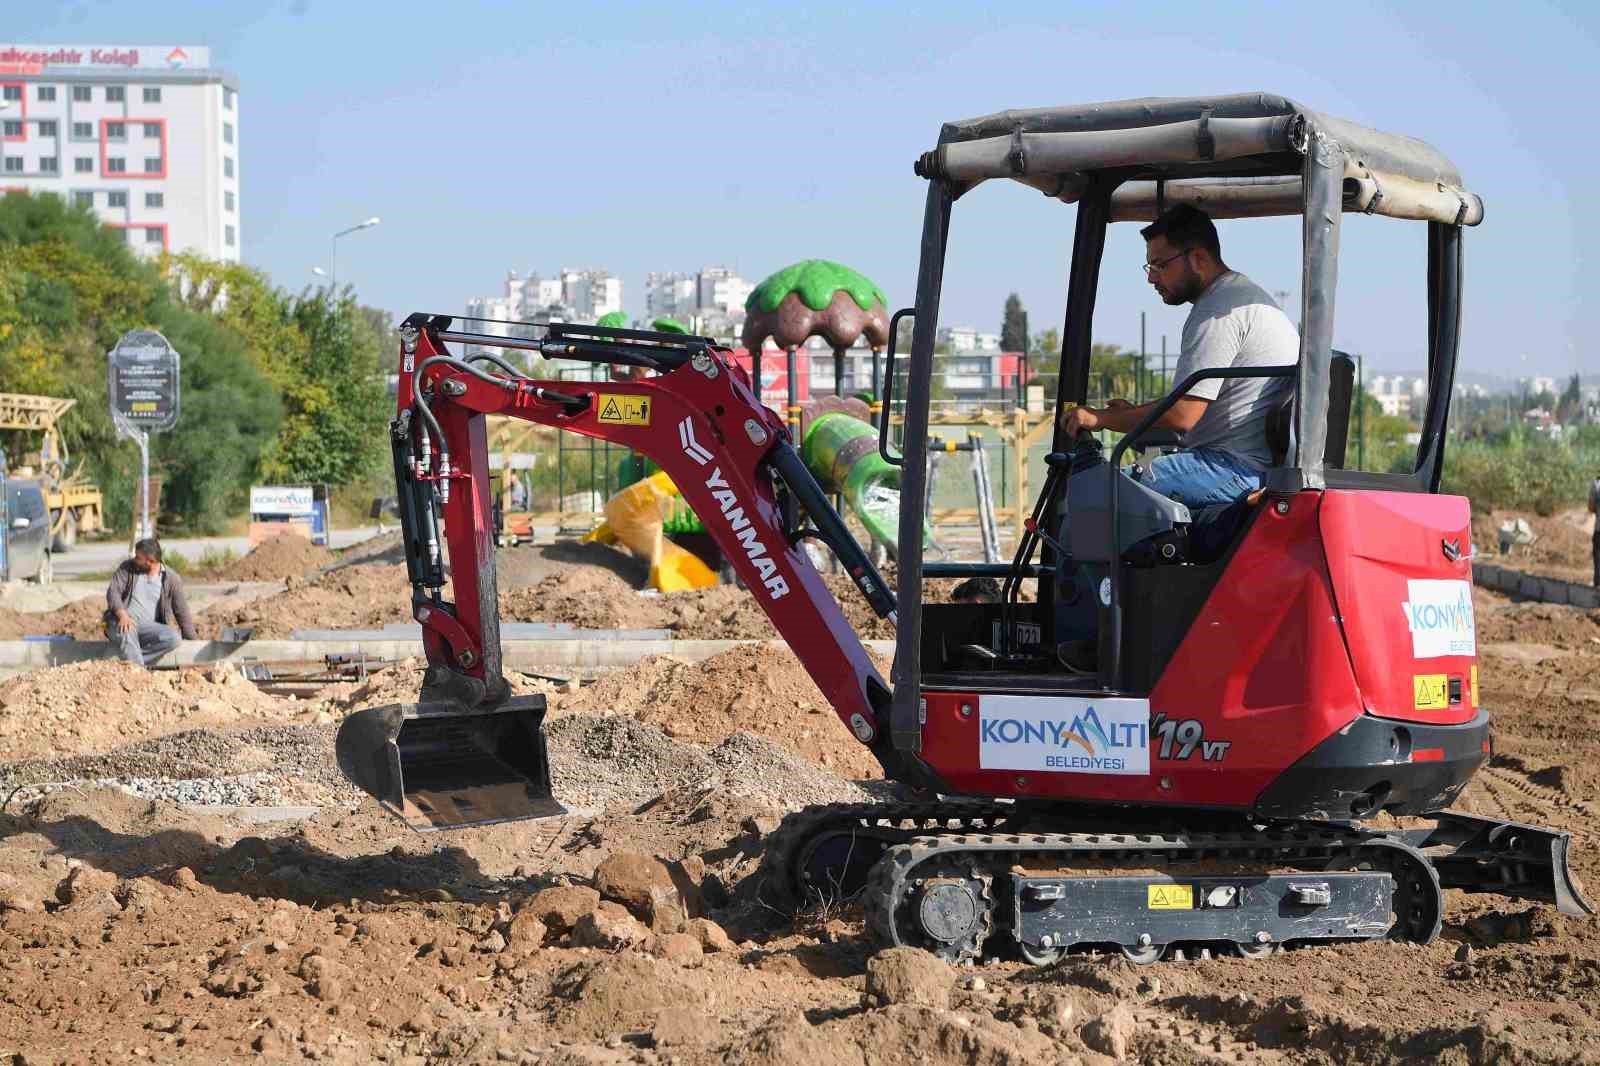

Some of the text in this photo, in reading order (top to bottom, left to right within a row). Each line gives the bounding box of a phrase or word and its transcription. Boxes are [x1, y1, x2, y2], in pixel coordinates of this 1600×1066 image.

[91, 48, 139, 67] Koleji
[705, 466, 790, 600] YANMAR
[981, 706, 1146, 755] KONYAALTI
